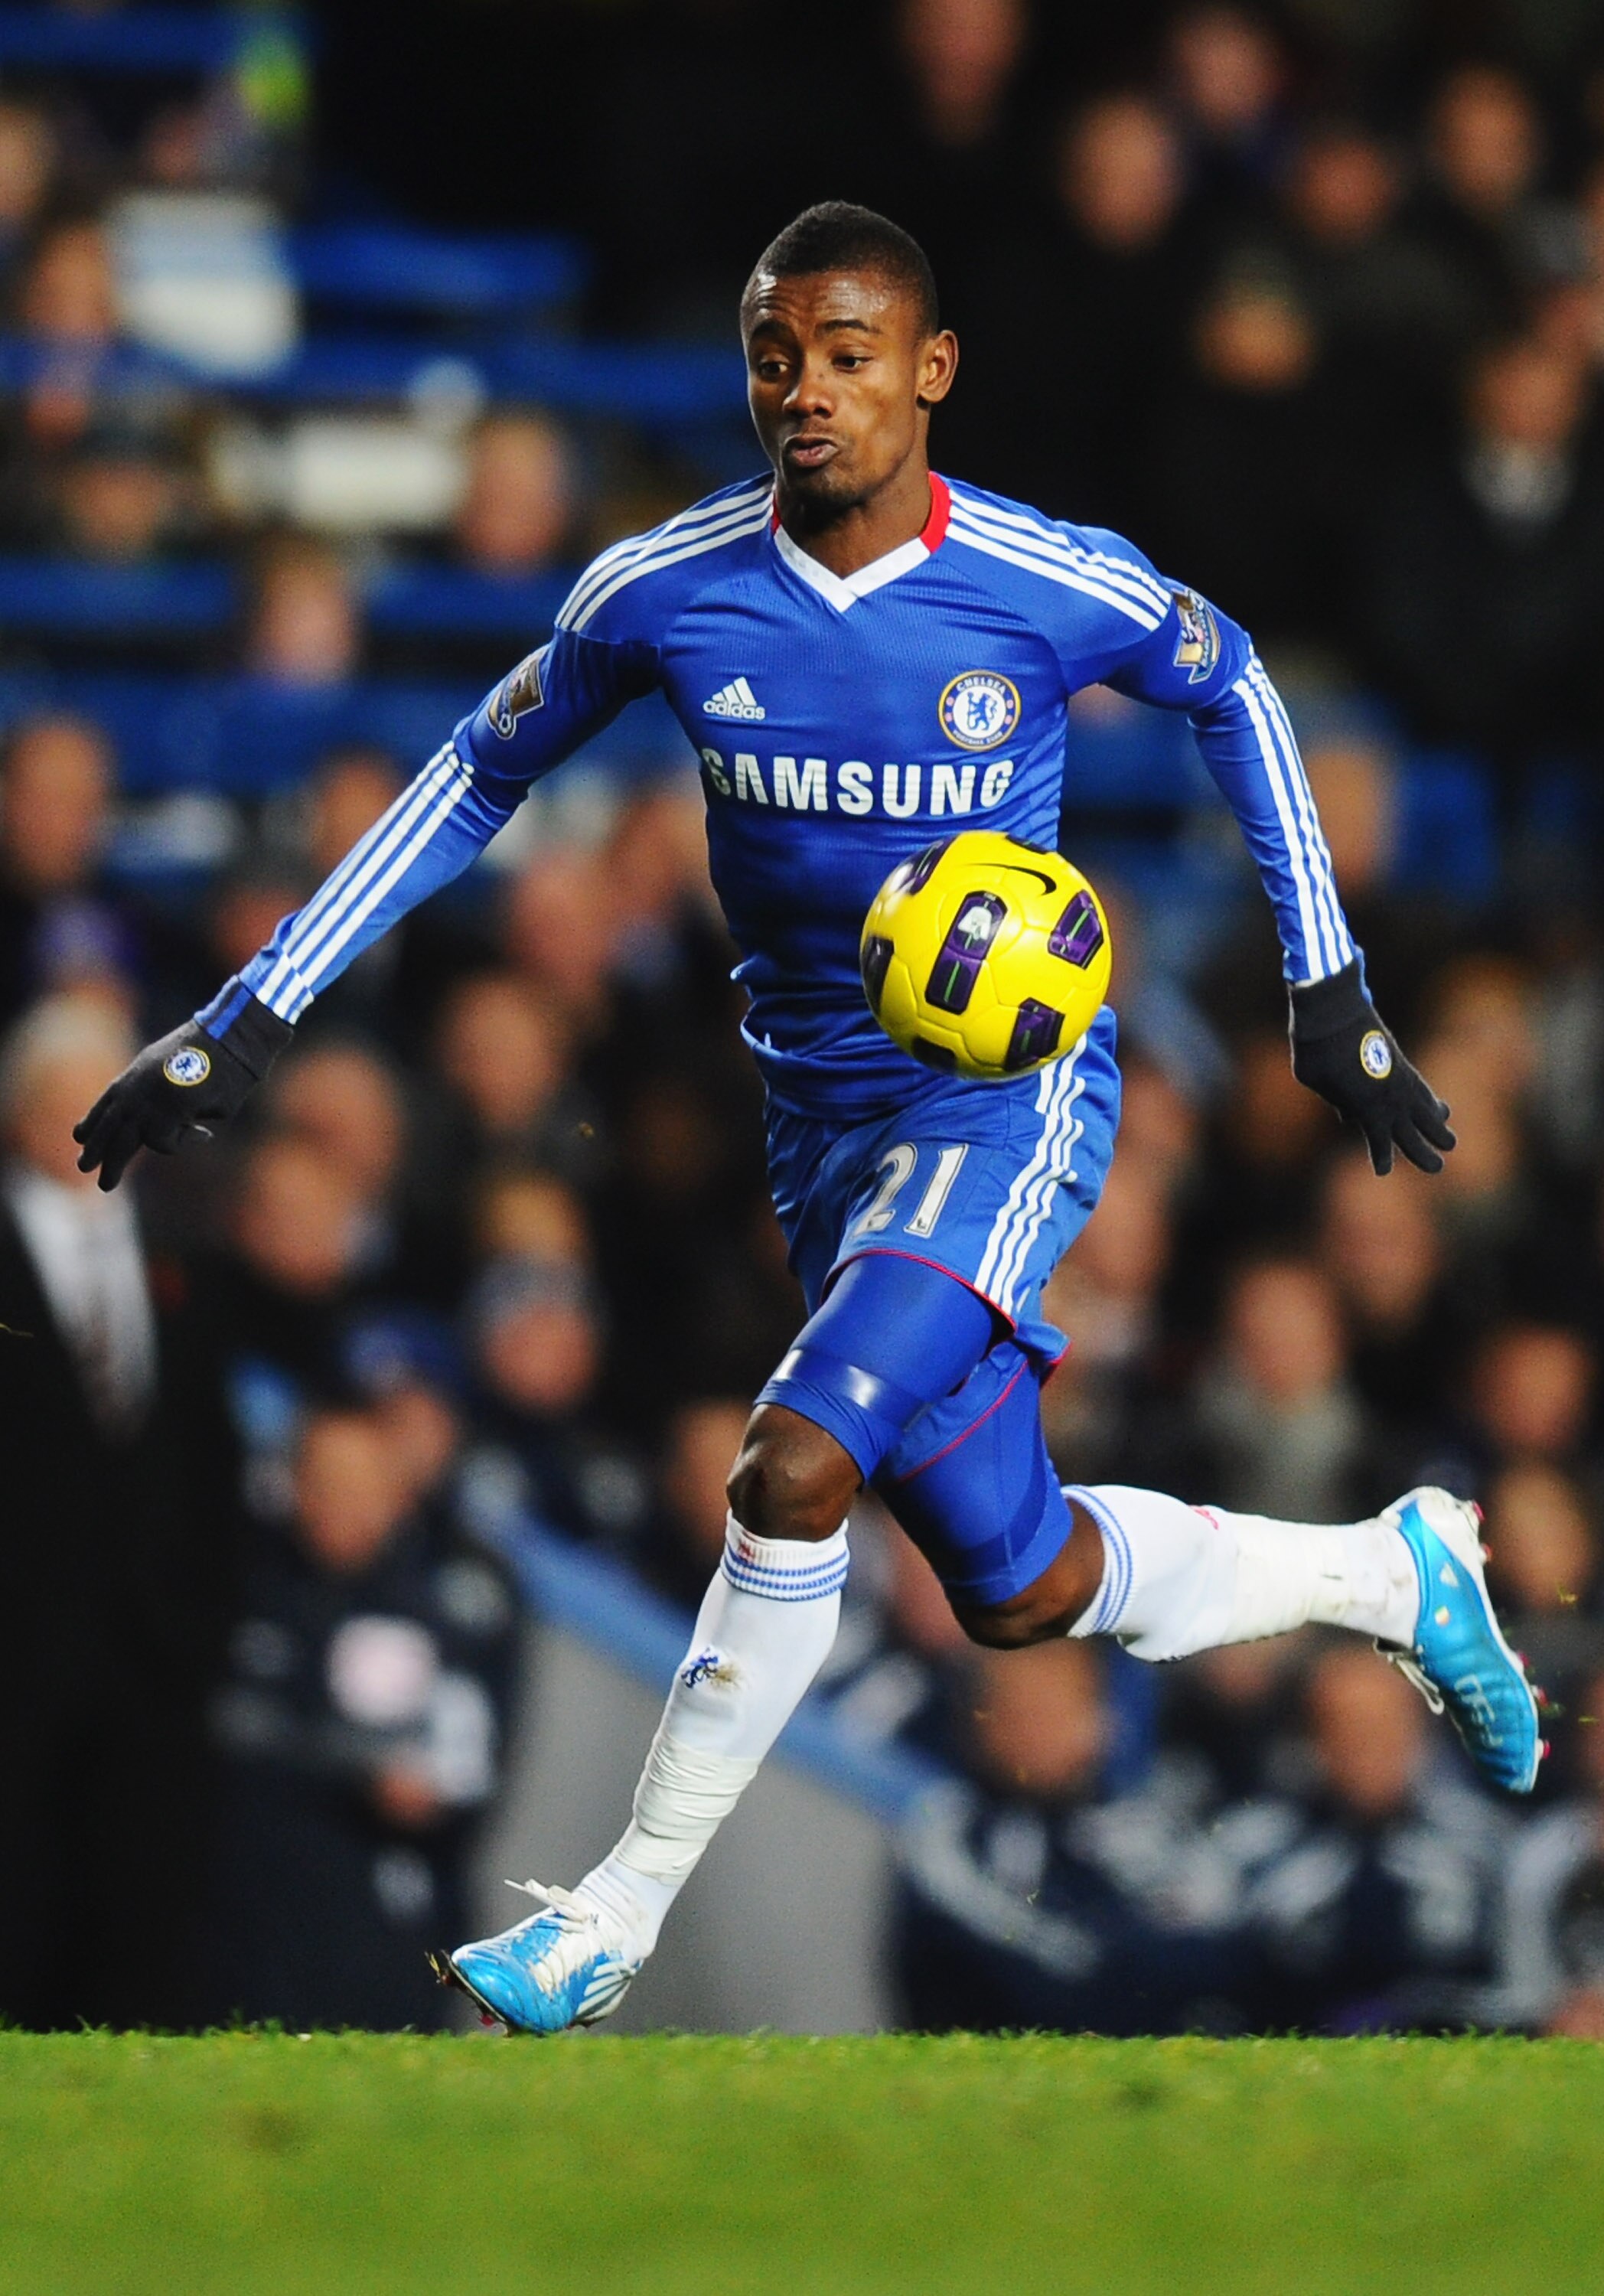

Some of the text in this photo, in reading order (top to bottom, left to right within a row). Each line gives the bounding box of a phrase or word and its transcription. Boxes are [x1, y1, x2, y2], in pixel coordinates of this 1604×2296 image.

[956, 677, 1006, 694] CHELSEA
[703, 700, 765, 720] adidas
[702, 748, 1014, 818] SAMSUNG
[853, 1142, 969, 1238] 21
